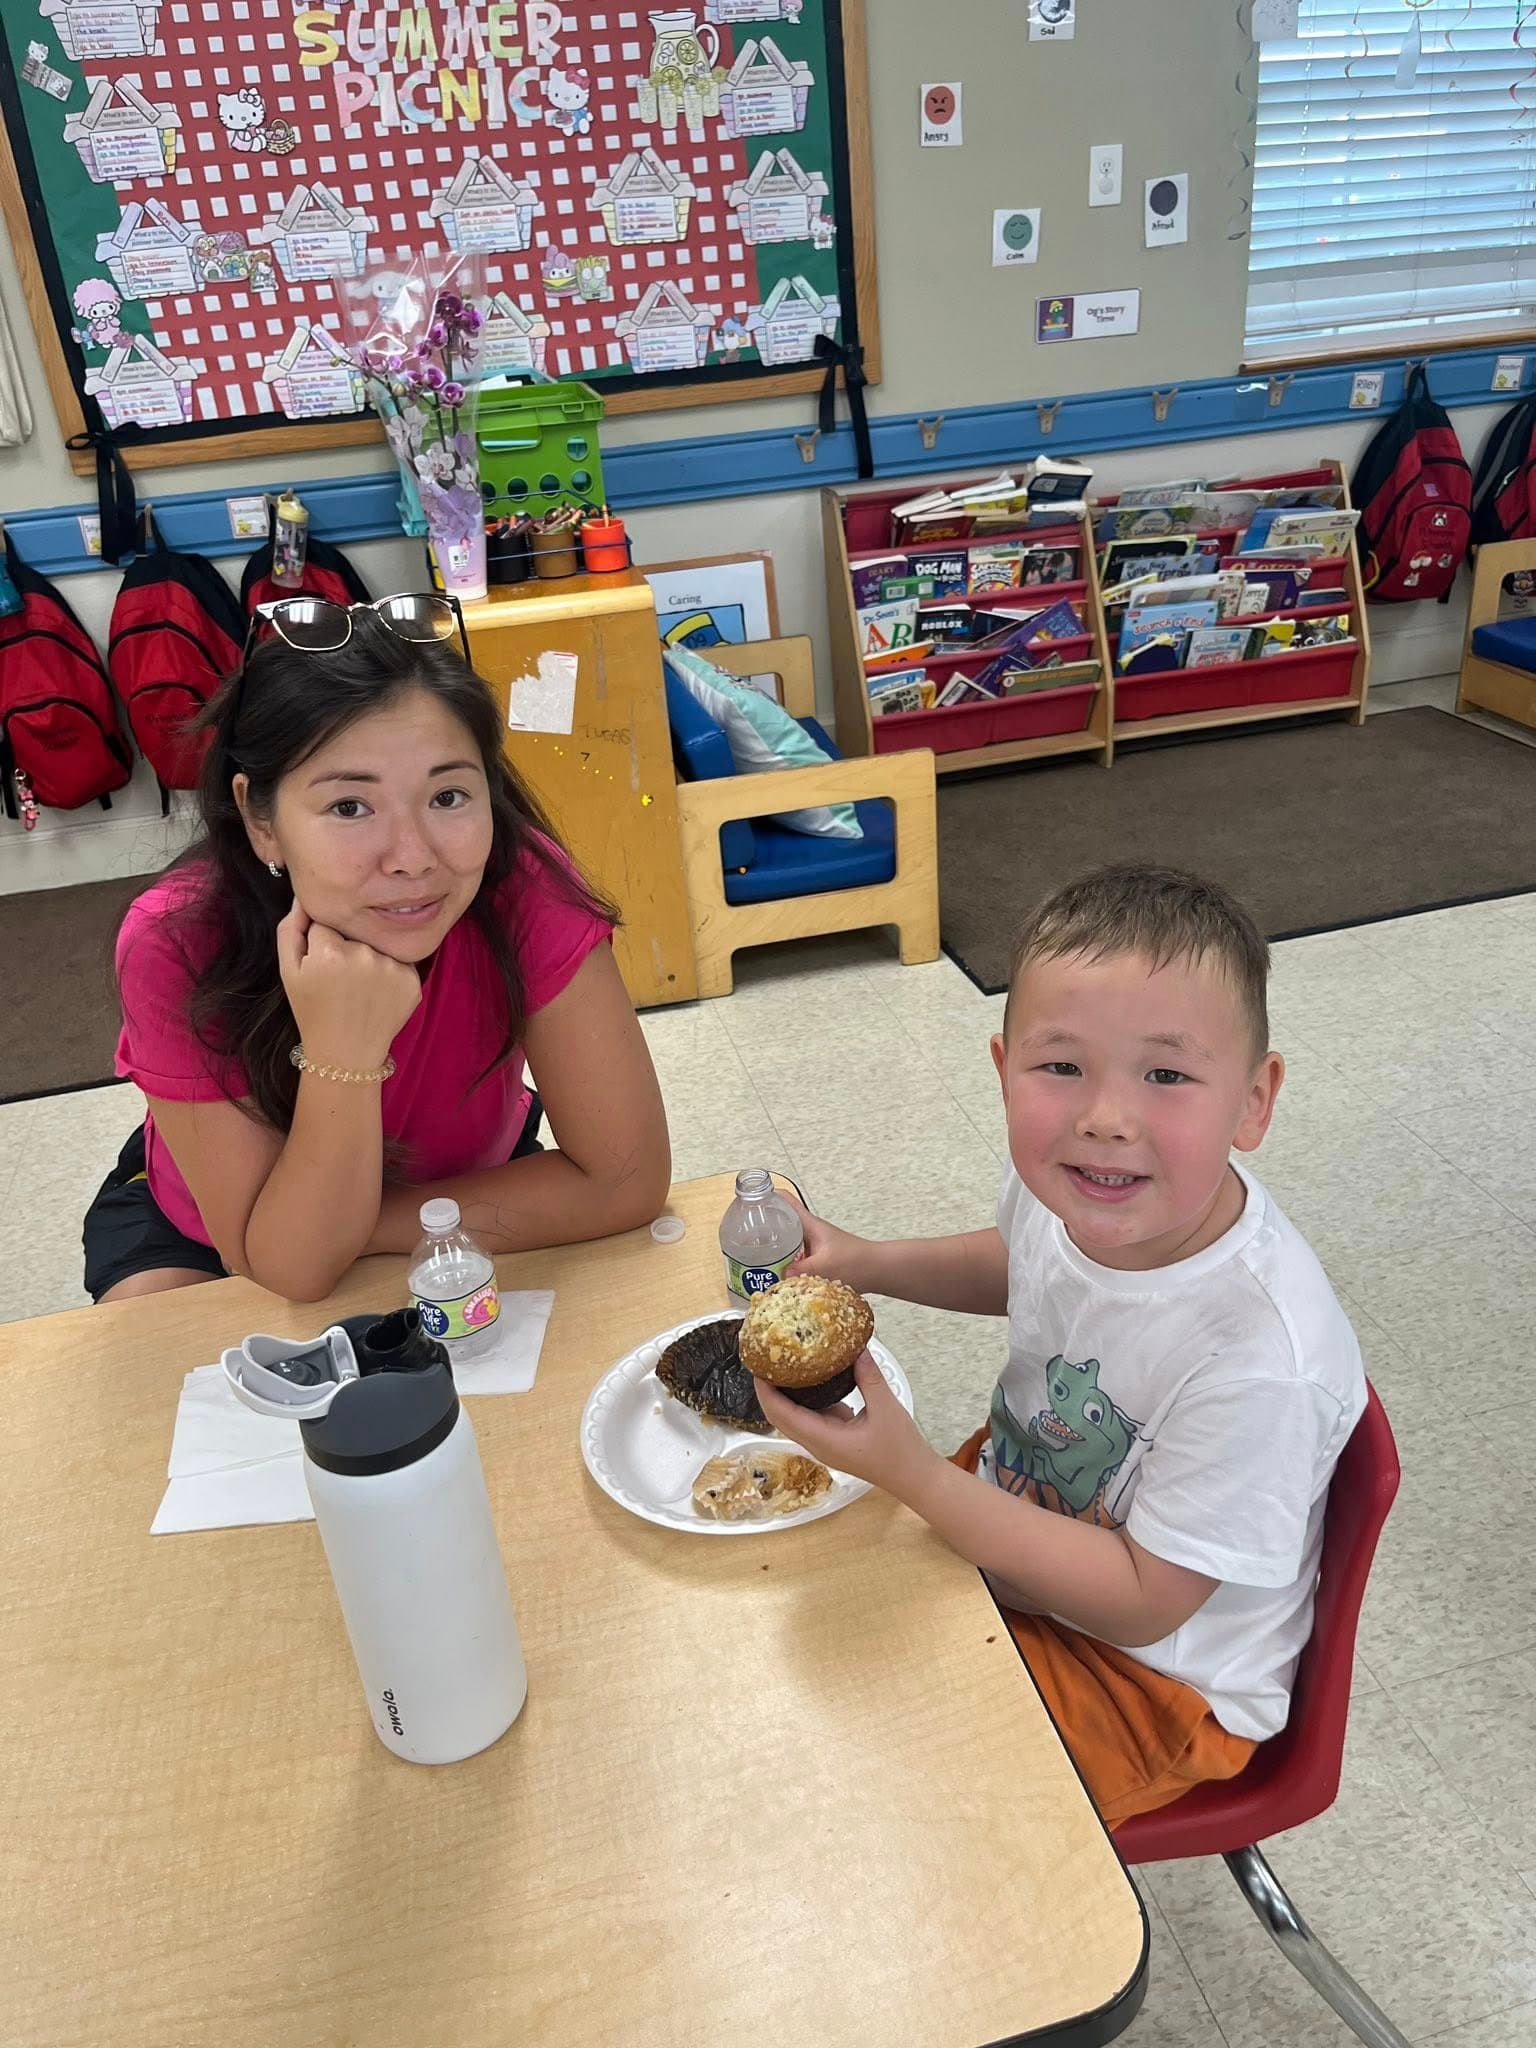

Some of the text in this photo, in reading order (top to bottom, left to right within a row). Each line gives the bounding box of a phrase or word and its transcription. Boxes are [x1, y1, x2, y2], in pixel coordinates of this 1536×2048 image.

[293, 3, 562, 66] SUMMER
[1040, 26, 1055, 35] Sad
[333, 67, 542, 128] PICNIC
[924, 132, 948, 142] Angry
[1152, 219, 1174, 230] Afraid
[1006, 252, 1024, 260] Calm
[1105, 305, 1125, 315] Story
[1097, 315, 1114, 323] Time
[1356, 379, 1378, 391] Riley
[915, 561, 962, 576] DOG MAN
[668, 593, 702, 606] Caring
[921, 620, 963, 631] ROBLOX
[745, 1271, 773, 1283] Pure
[750, 1280, 771, 1291] Life
[419, 1302, 441, 1317] Pure
[422, 1311, 441, 1326] Life
